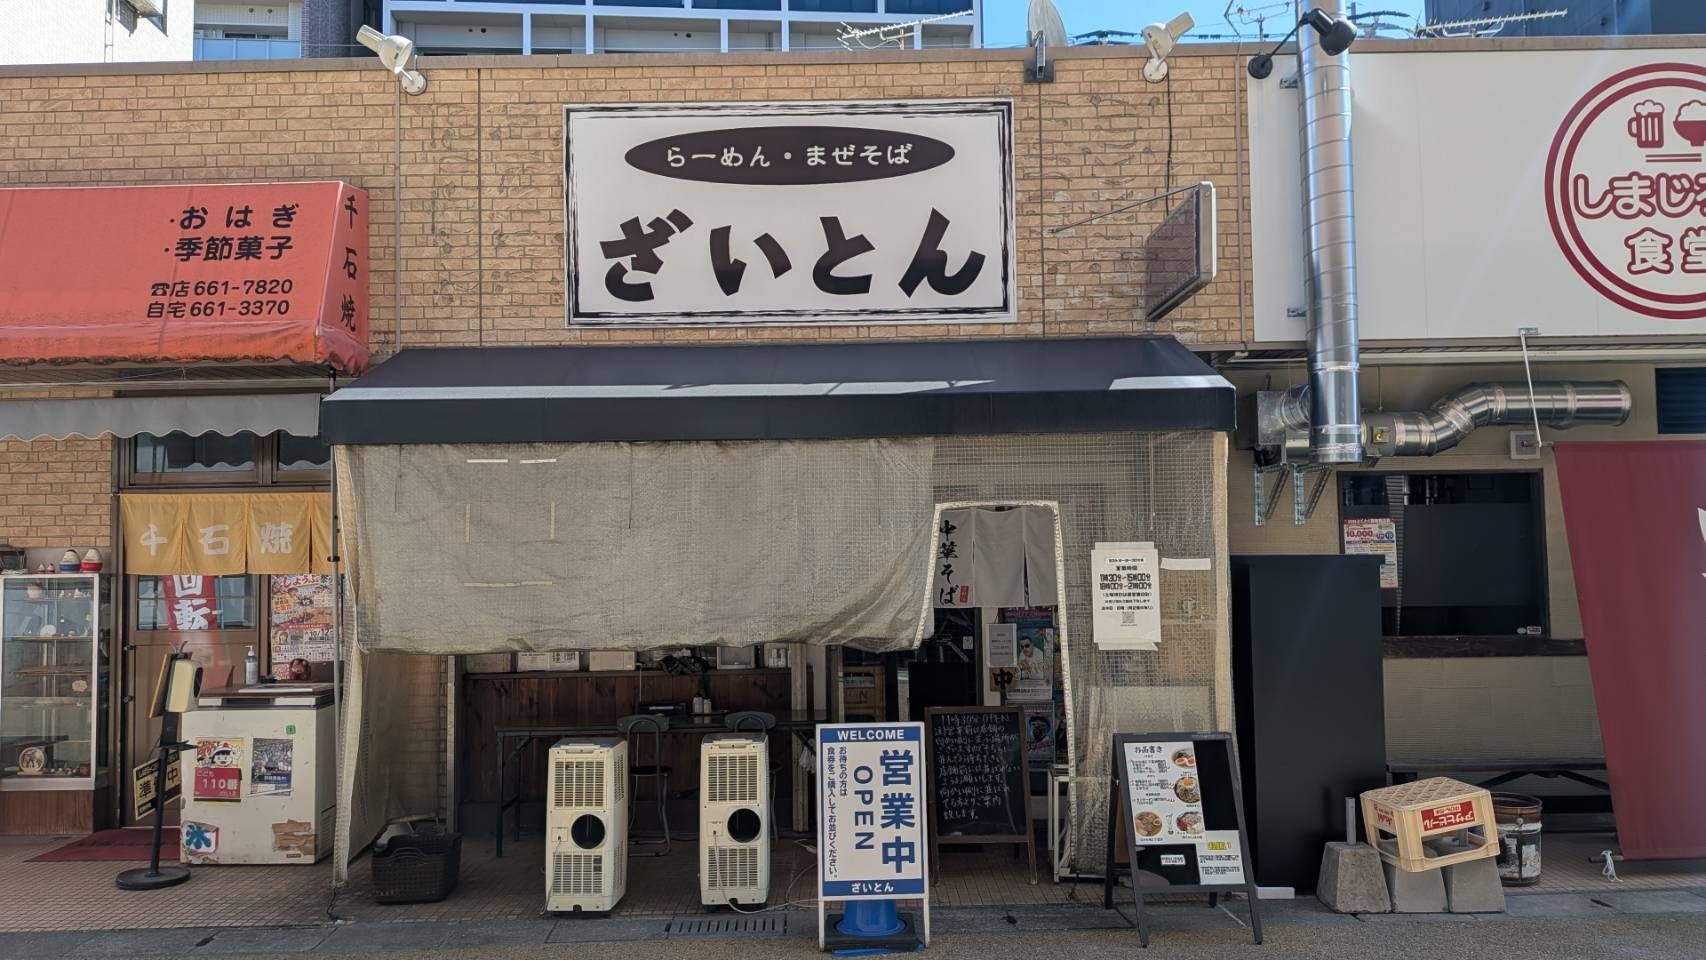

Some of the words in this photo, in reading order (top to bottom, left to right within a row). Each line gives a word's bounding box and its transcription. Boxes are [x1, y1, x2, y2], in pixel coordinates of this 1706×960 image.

[667, 142, 913, 168] らーめん・まぜそば
[1573, 170, 1706, 219] しまじ
[340, 194, 359, 333] 千石焼
[599, 206, 987, 303] ざいとん
[139, 523, 294, 557] 千石焼
[938, 519, 960, 606] 中華そば
[836, 729, 905, 742] WELCOME
[838, 746, 848, 797] お待ちの方は
[853, 764, 875, 850] OPEN
[880, 748, 916, 874] 営業中
[851, 882, 894, 893] ざいとん
